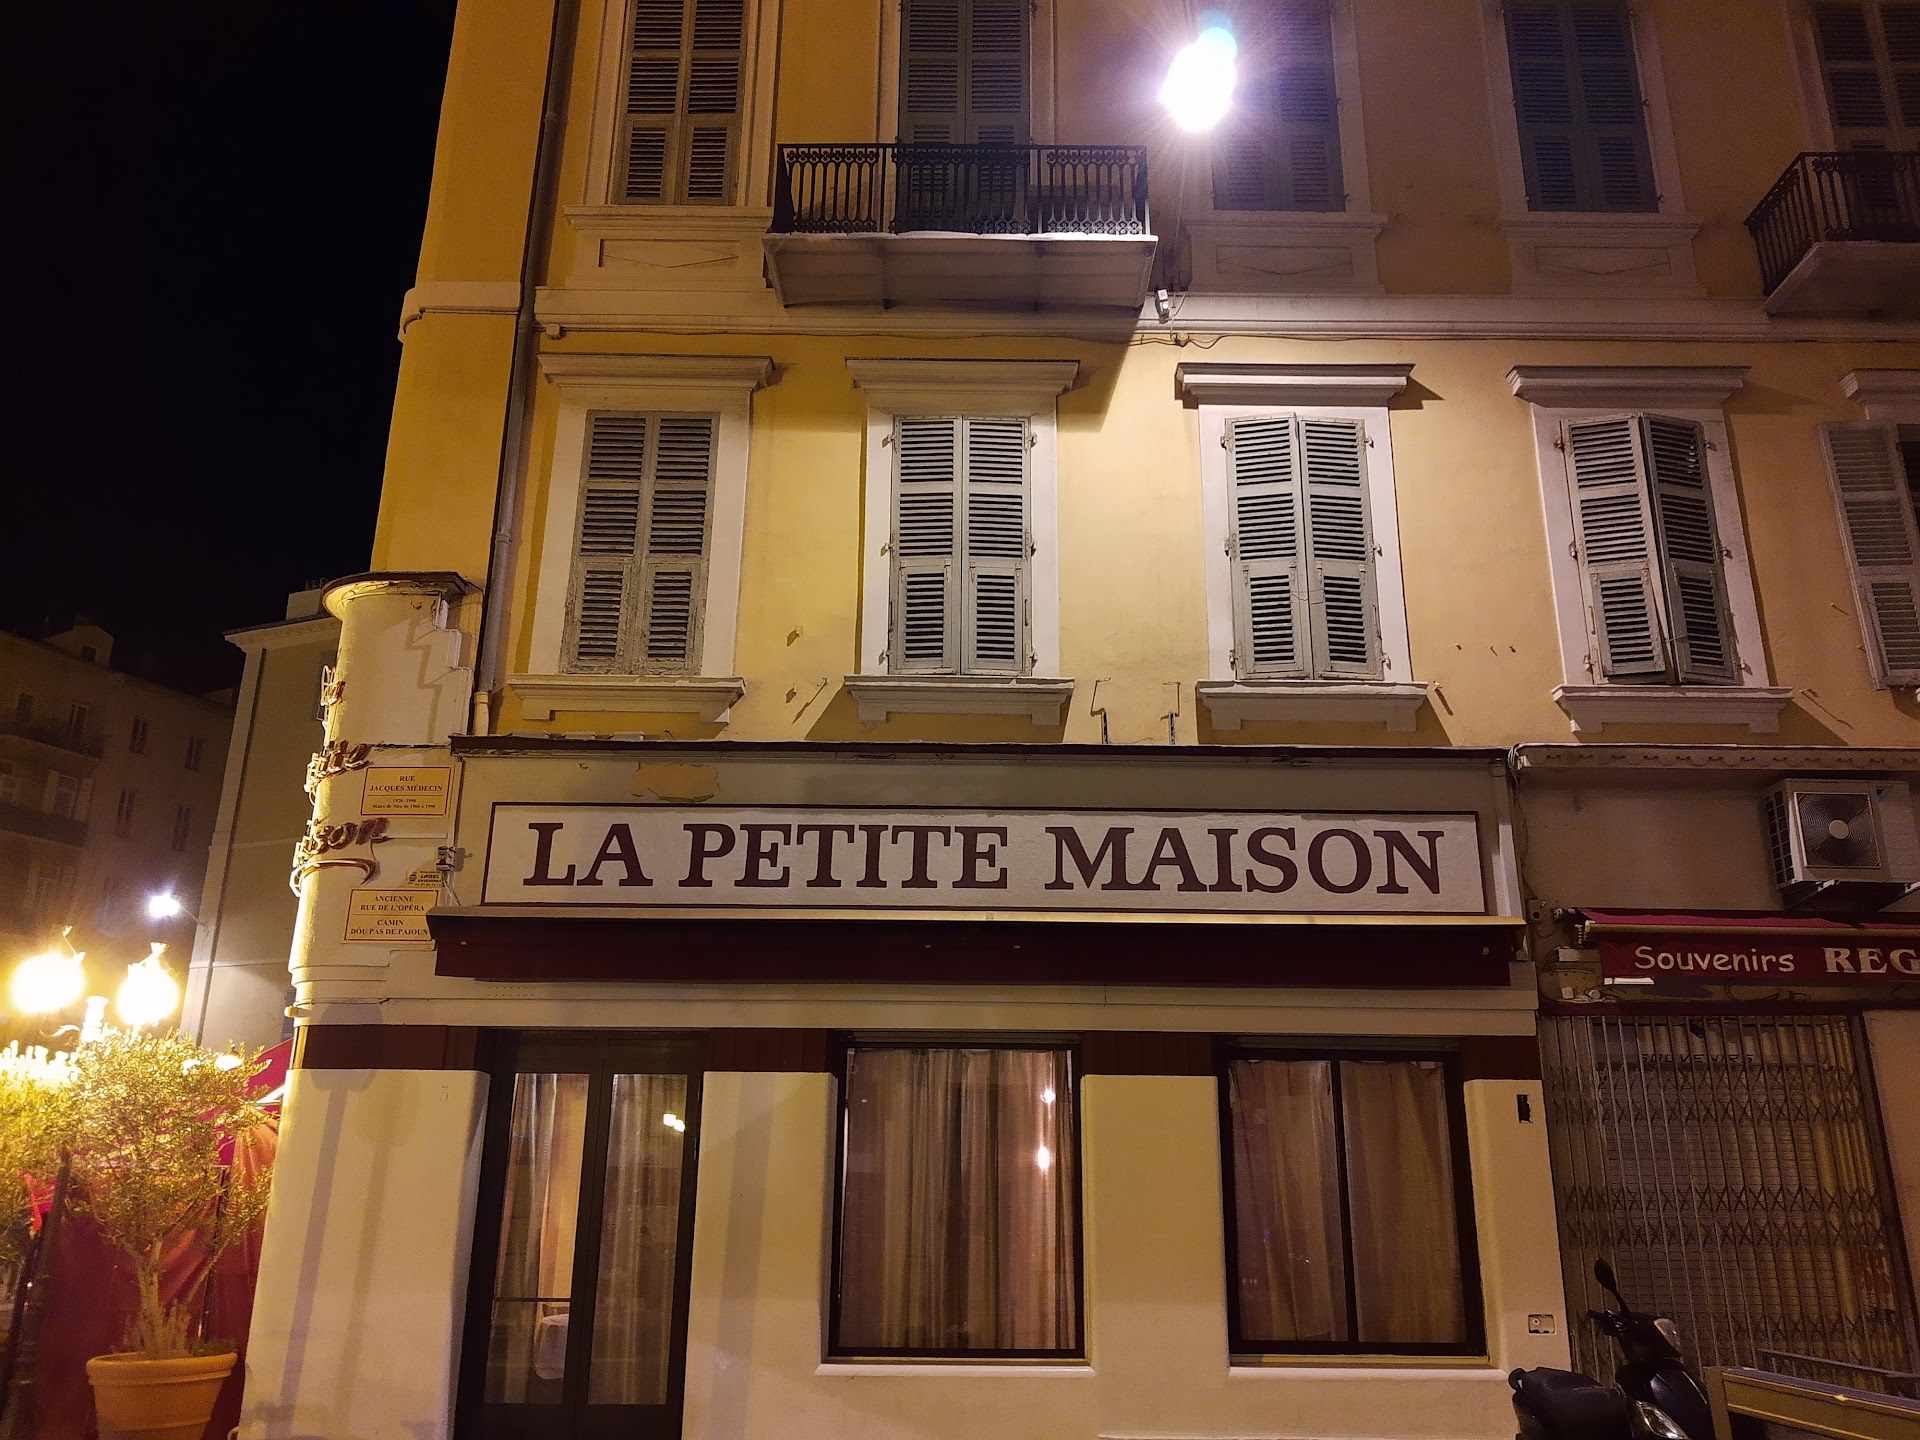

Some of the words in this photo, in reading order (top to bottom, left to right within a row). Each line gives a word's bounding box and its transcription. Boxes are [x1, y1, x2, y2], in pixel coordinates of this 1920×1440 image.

[407, 784, 443, 792] MÉDECIN
[523, 822, 654, 887] LA
[678, 823, 1008, 889] PETITE
[1044, 826, 1445, 895] MAISON
[374, 895, 414, 903] ANCIENNE
[390, 903, 425, 911] L'OPÉRA
[1634, 945, 1795, 973] Souvenirs
[1822, 946, 1920, 975] REG
